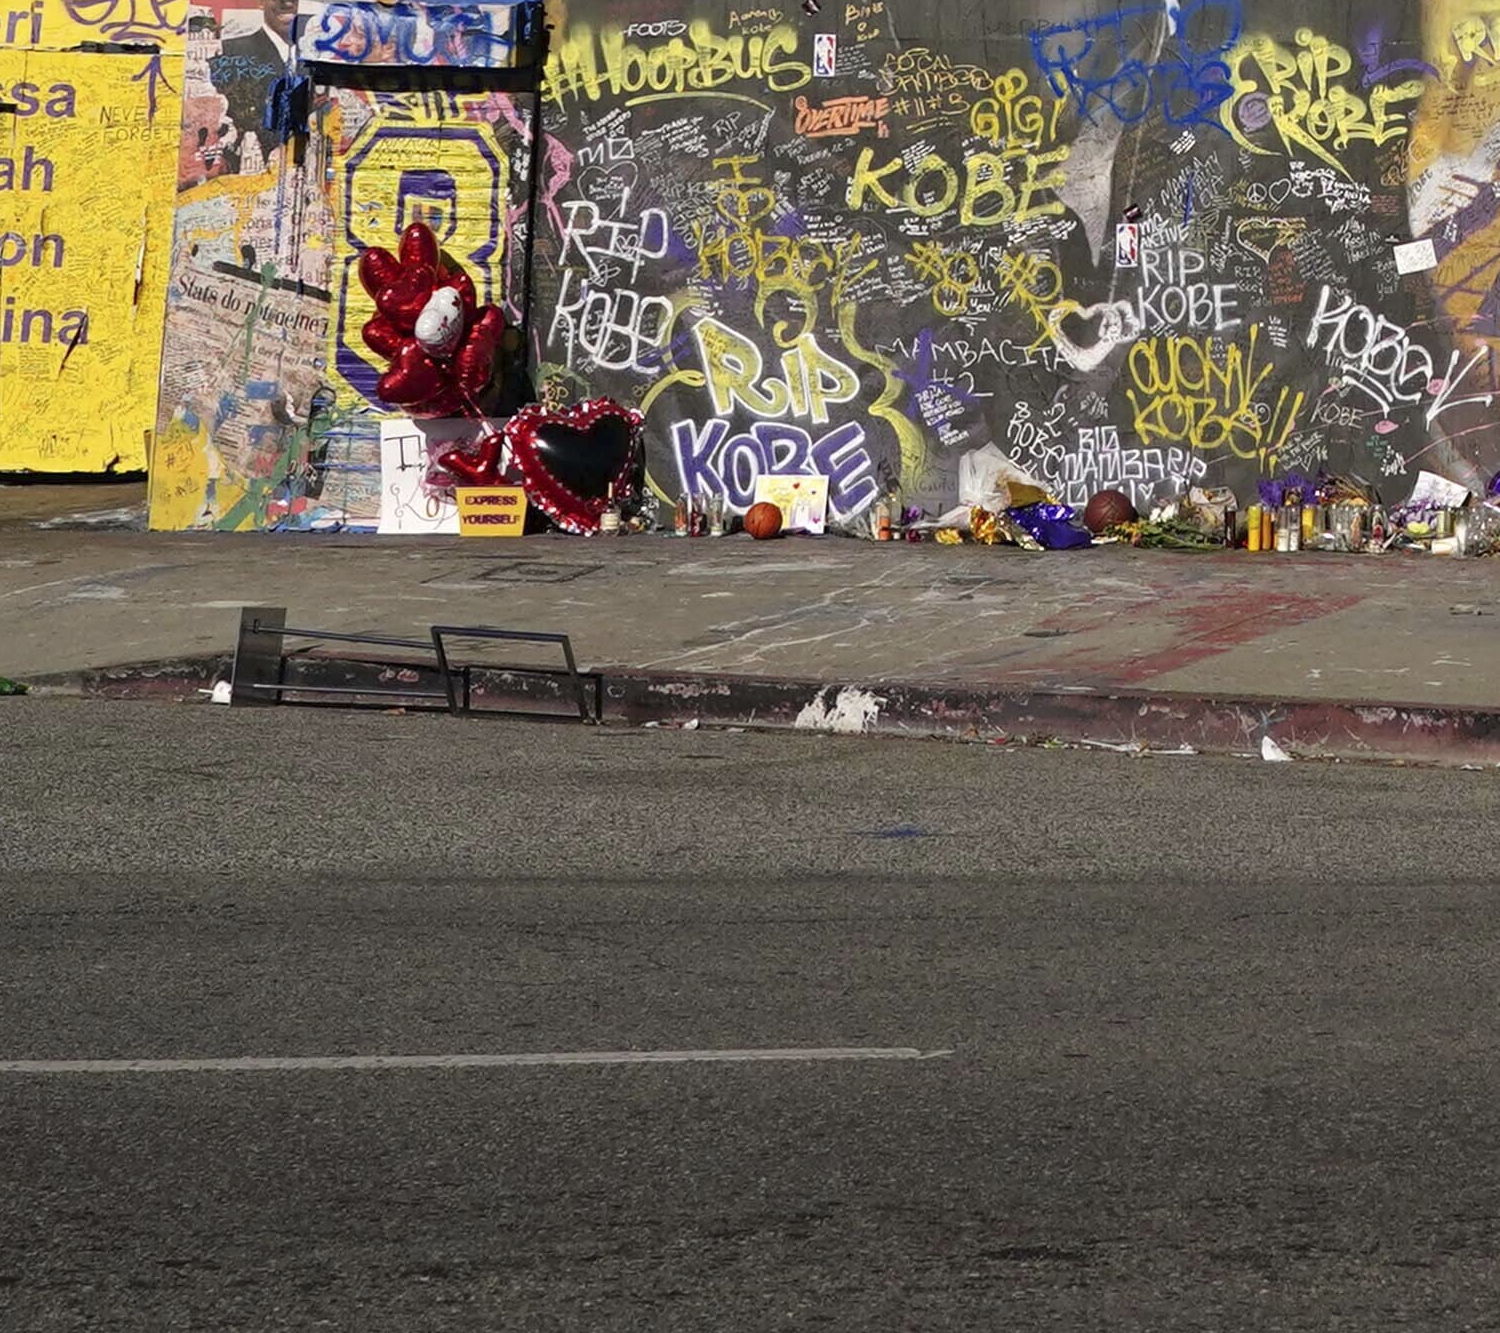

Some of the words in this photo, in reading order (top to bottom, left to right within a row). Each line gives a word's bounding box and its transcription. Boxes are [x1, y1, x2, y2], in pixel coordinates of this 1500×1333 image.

[847, 145, 1071, 226] KOBE
[1142, 247, 1206, 289] RIP
[178, 273, 218, 306] Stats
[220, 288, 241, 311] do
[1137, 283, 1242, 331] KOBE
[1310, 399, 1366, 429] KOBE
[1078, 425, 1121, 452] BIG
[671, 419, 880, 521] KOBE
[1065, 448, 1166, 482] MAMBA
[462, 513, 522, 525] YOURSELF
[464, 495, 518, 507] EXPRESS
